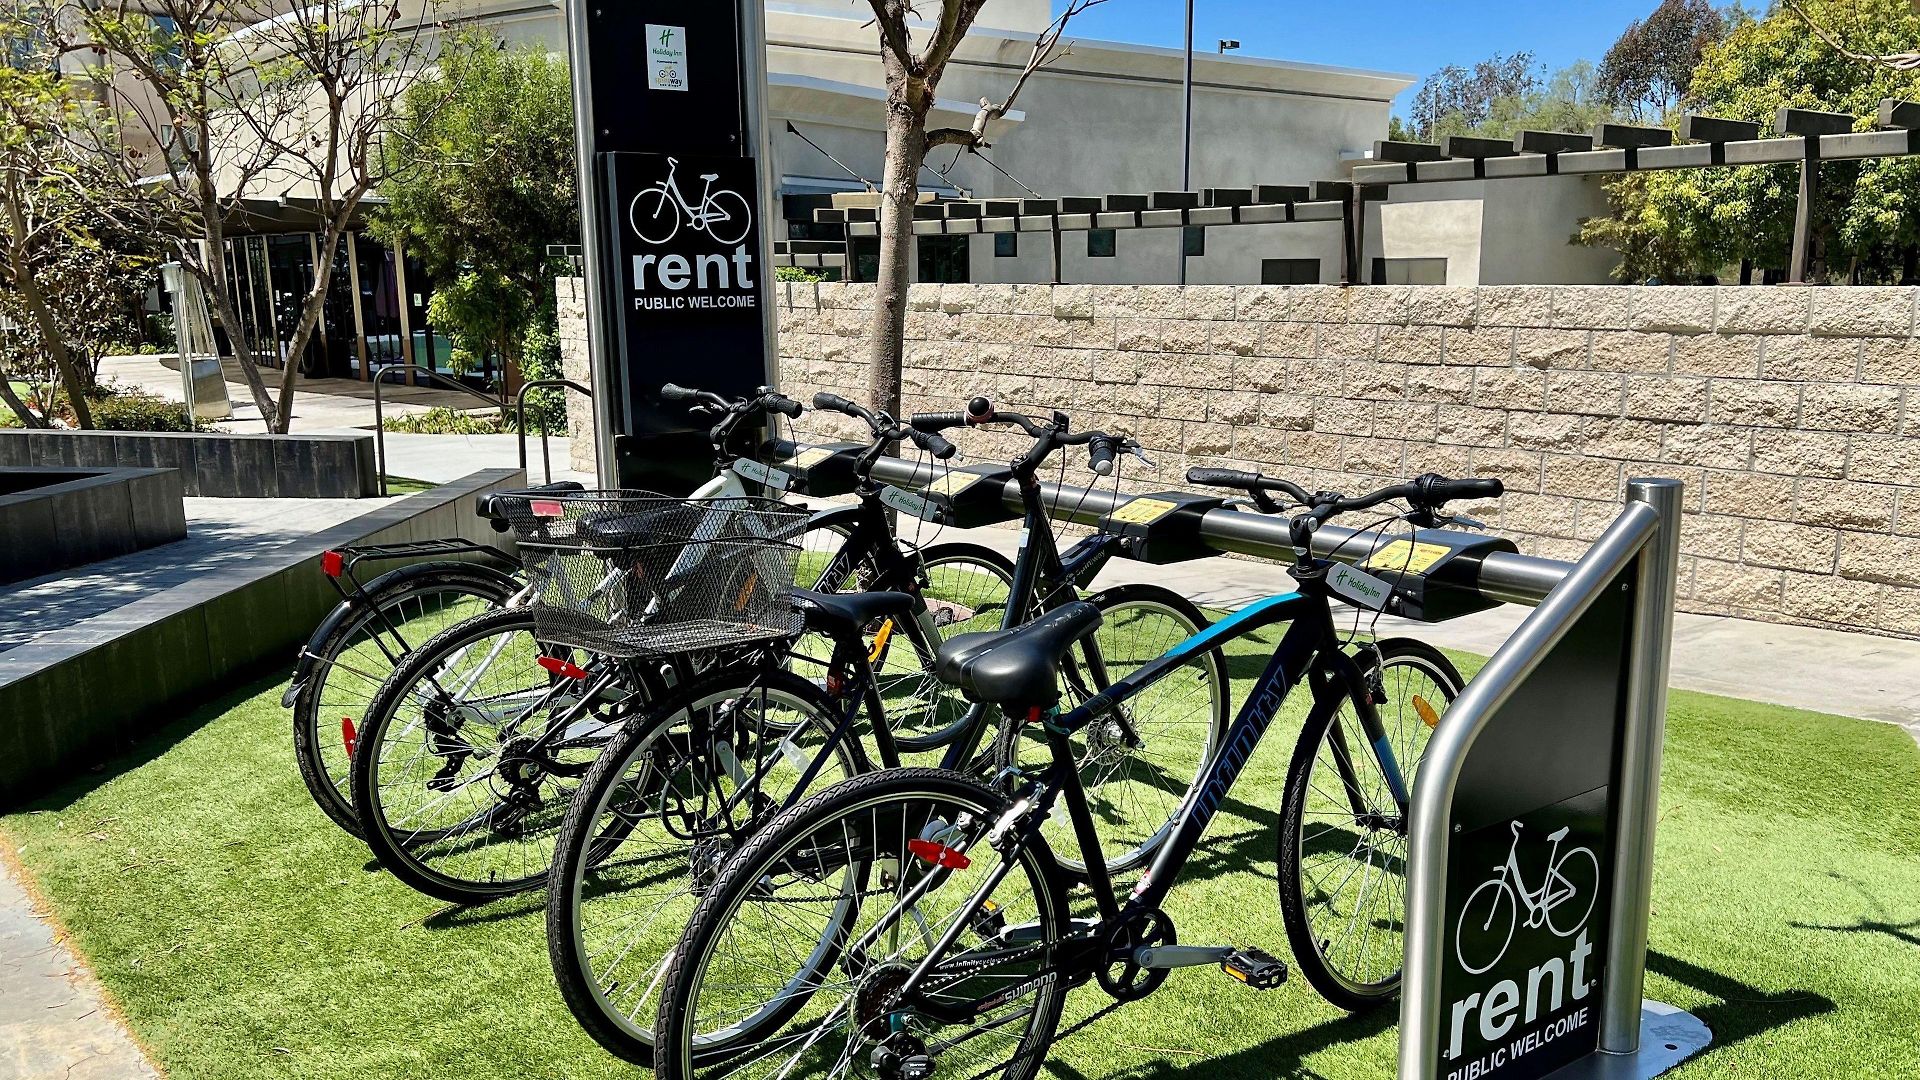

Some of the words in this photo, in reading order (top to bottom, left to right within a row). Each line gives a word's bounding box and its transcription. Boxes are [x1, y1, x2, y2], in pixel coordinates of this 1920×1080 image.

[652, 48, 673, 57] Holiday
[632, 244, 754, 290] rent
[634, 297, 685, 310] PUBLIC
[688, 295, 755, 309] WELCOME
[1347, 576, 1370, 596] Holiday
[1370, 586, 1381, 599] Inn
[1004, 971, 1058, 1001] SHIMANO
[1449, 926, 1593, 1060] rent
[1510, 1006, 1589, 1060] WELCOME
